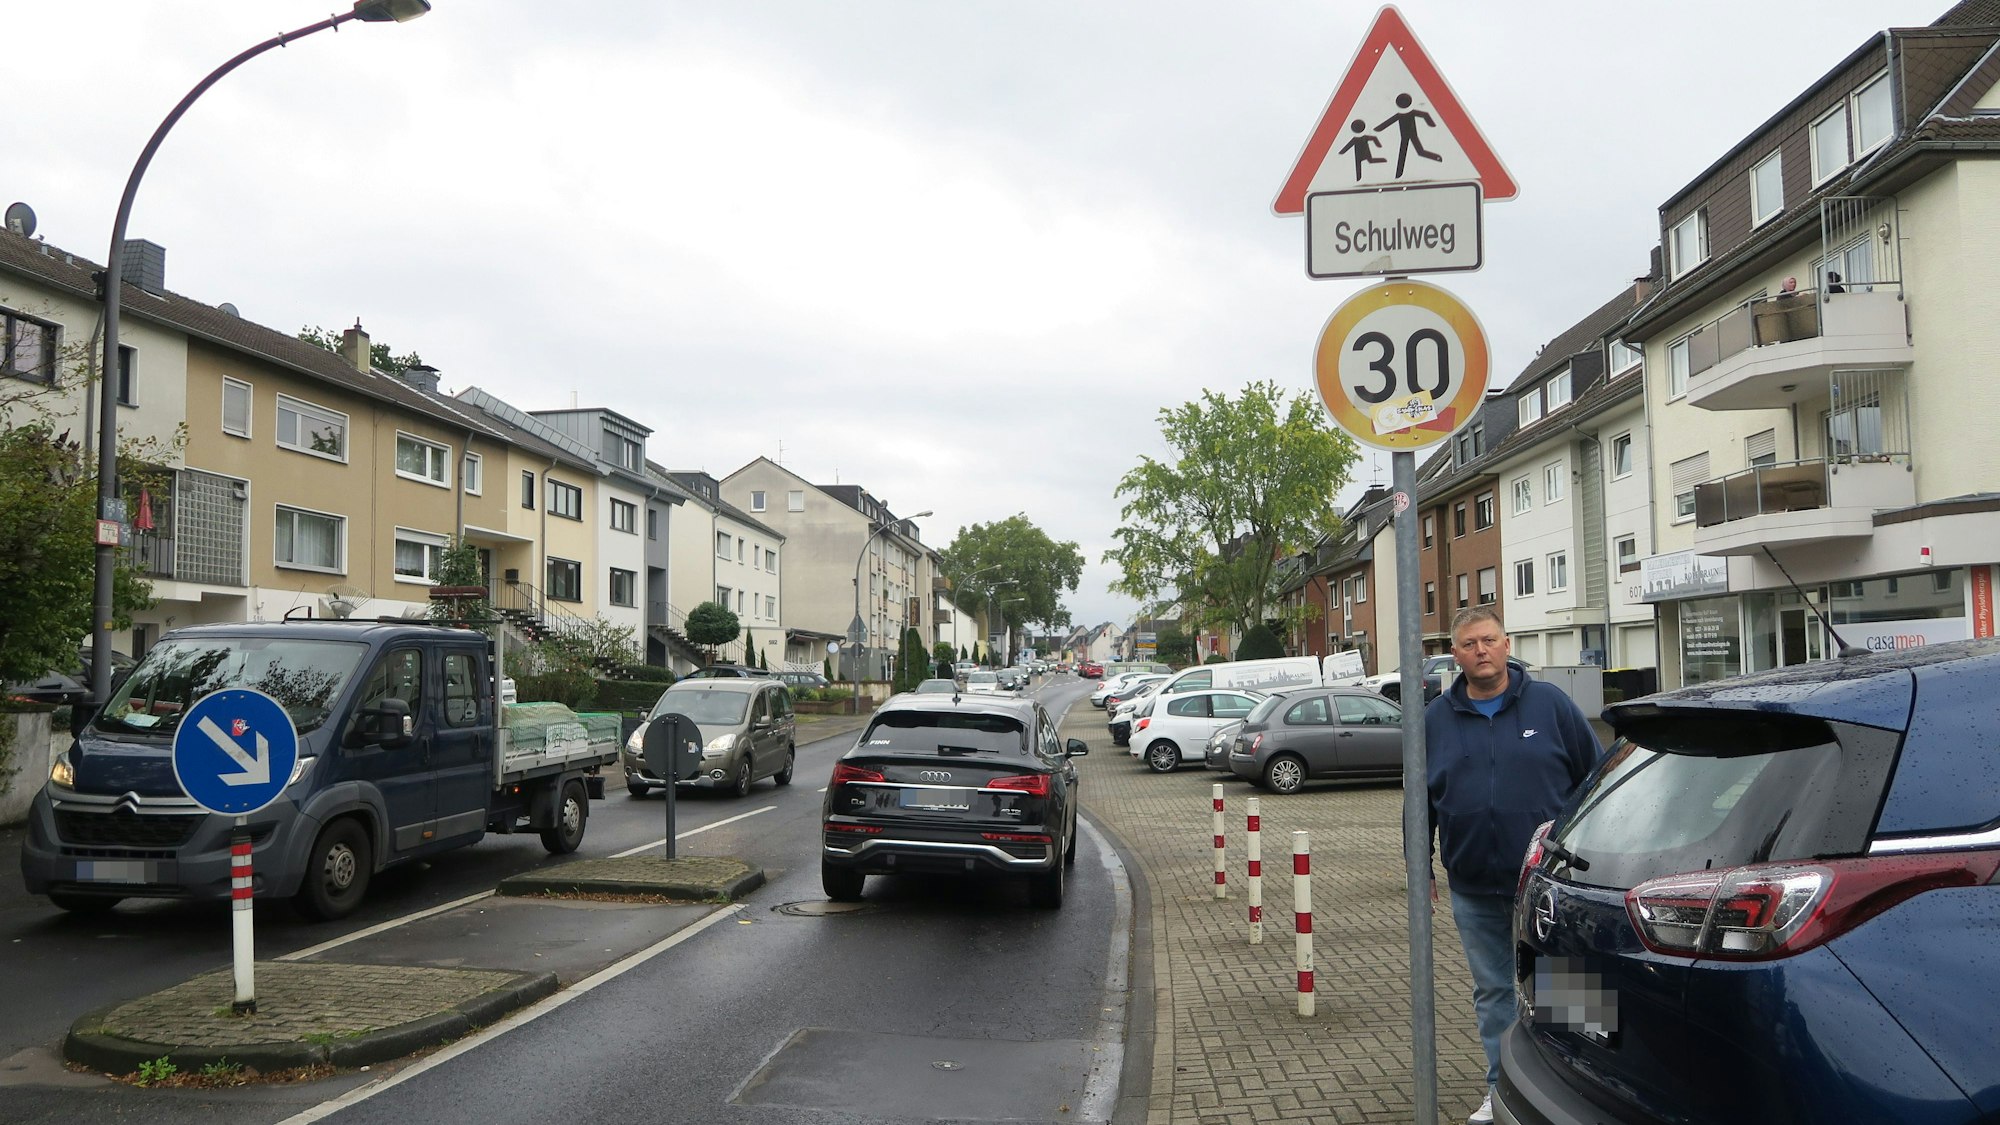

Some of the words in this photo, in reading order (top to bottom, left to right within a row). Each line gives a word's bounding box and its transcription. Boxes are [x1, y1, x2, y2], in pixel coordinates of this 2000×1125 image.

[1335, 218, 1455, 254] Schulweg
[1352, 328, 1450, 403] 30
[1629, 586, 1642, 598] 607
